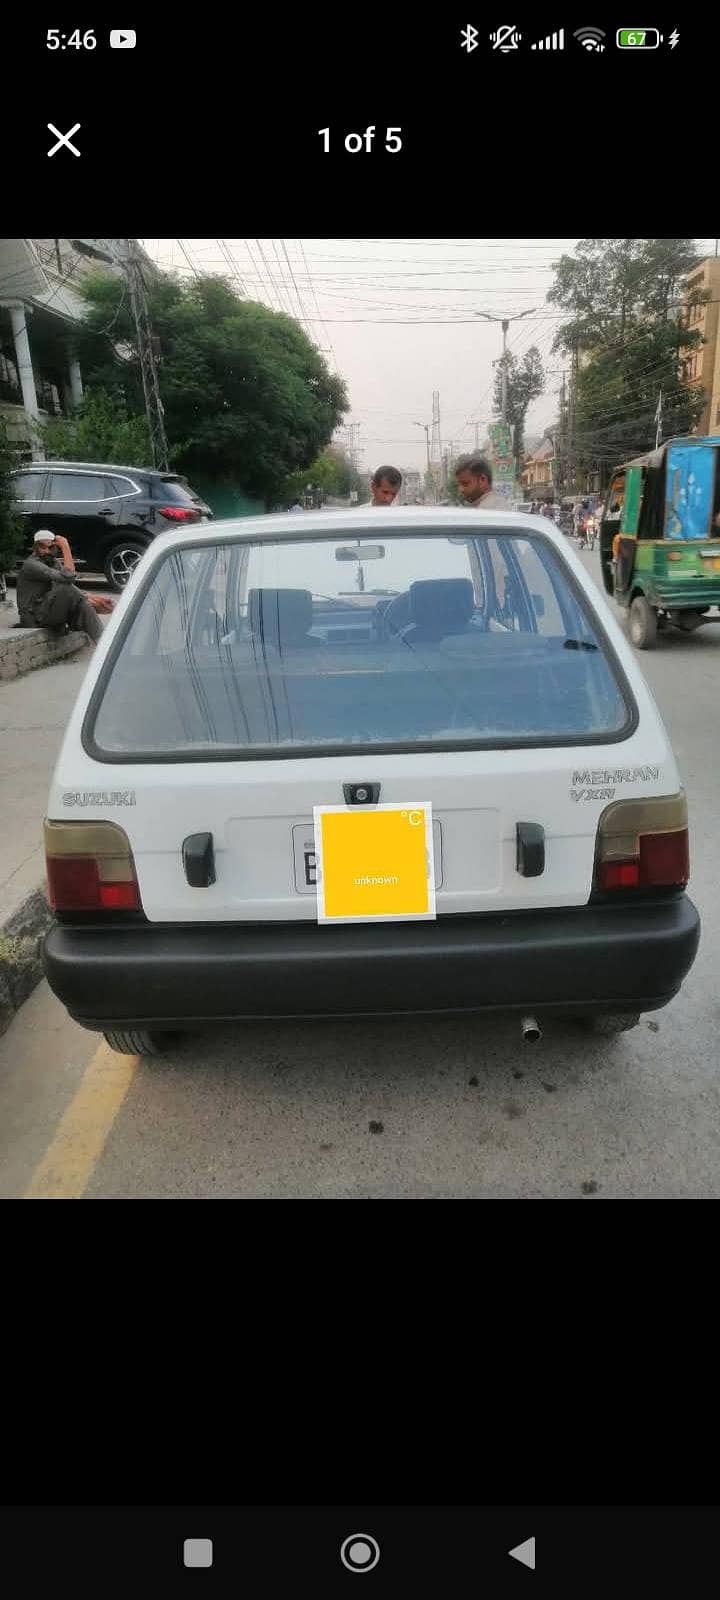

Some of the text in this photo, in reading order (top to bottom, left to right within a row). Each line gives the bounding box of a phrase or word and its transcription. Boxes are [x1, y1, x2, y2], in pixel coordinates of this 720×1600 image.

[45, 29, 97, 51] 5:46
[627, 31, 646, 47] 67
[317, 126, 403, 153] 1 of 5
[572, 766, 660, 785] MEHRAN
[63, 791, 137, 807] SUZUKI
